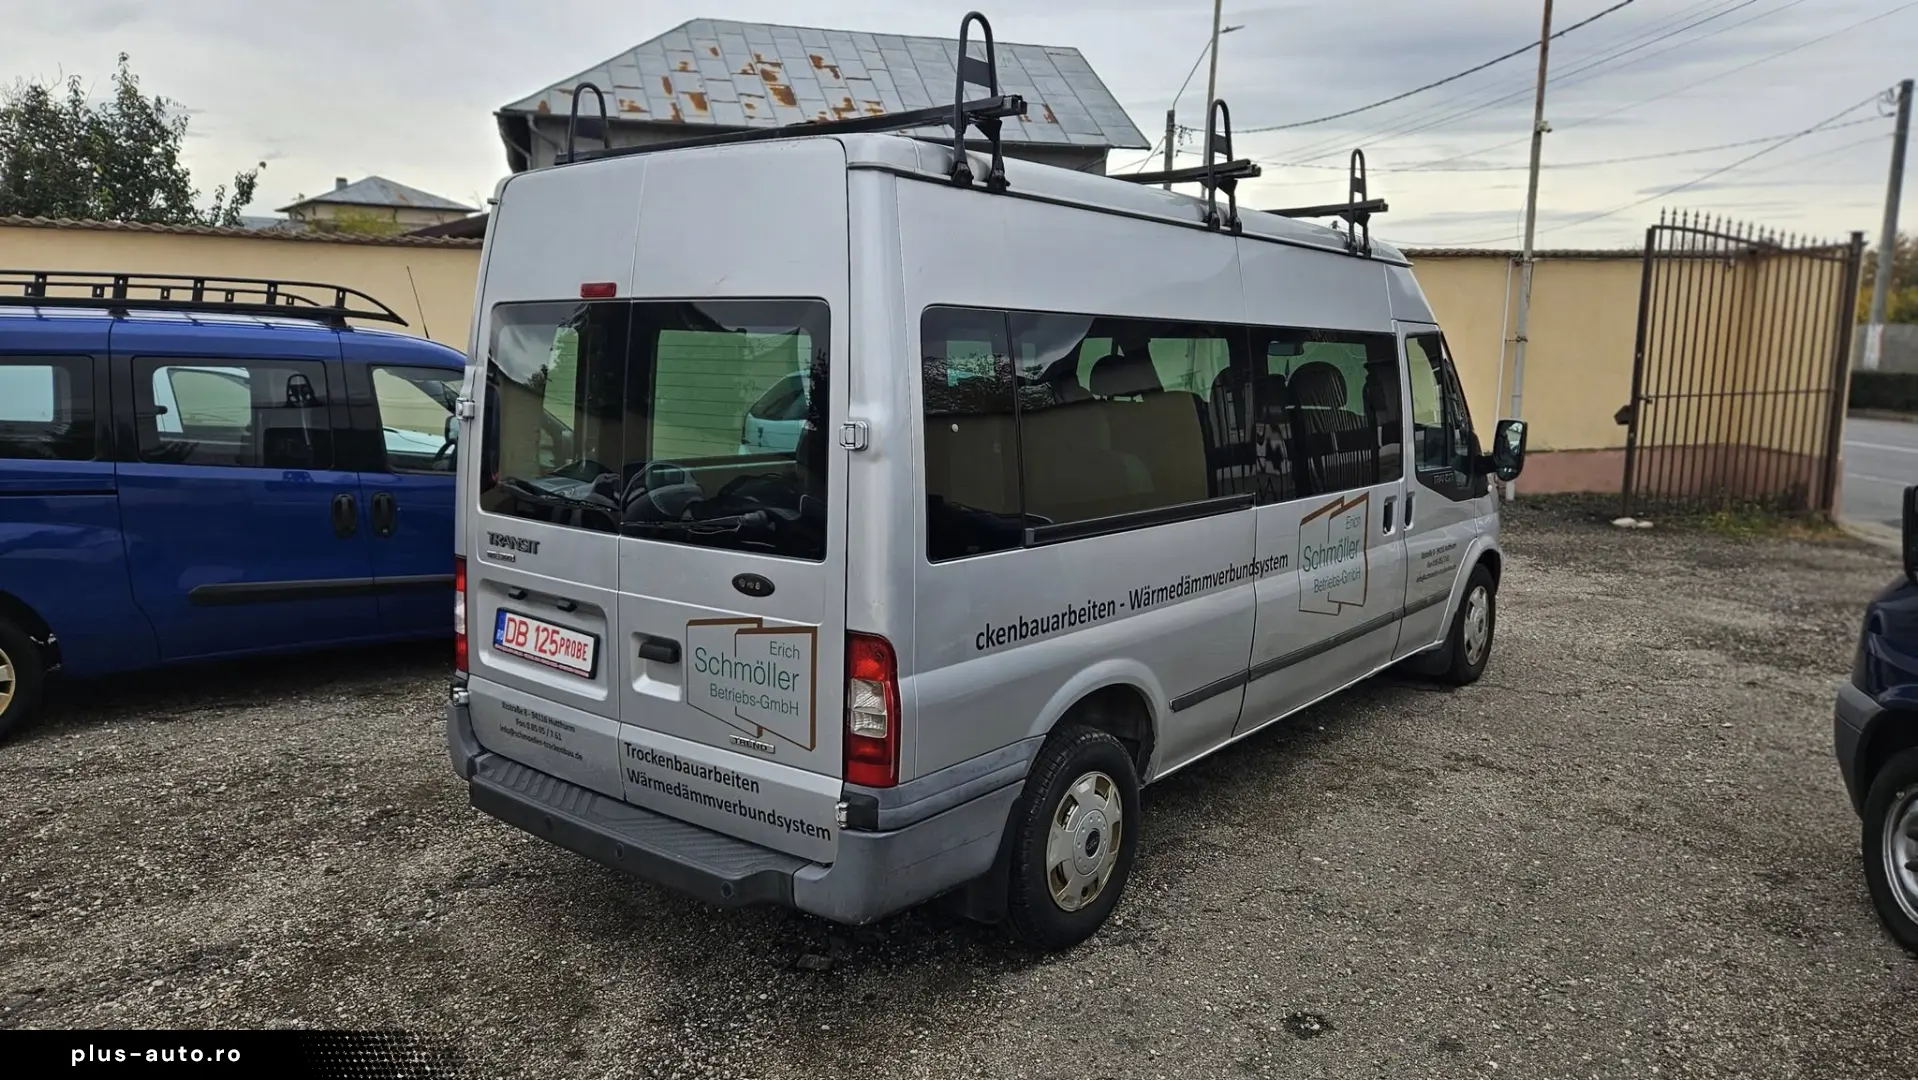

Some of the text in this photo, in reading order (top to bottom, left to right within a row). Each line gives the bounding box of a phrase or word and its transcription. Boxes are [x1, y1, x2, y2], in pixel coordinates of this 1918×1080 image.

[487, 531, 540, 554] TRANSIT
[1302, 536, 1360, 572] Schmöller
[1313, 566, 1361, 593] Betriebs-GmbH
[975, 599, 1115, 651] ckenbauarbeiten
[1129, 553, 1289, 610] Wärmedämmverbundsystem
[505, 617, 529, 647] DB
[769, 641, 800, 660] Erich
[695, 646, 800, 692] Schmöller
[709, 682, 799, 716] Betriebs-GmbH
[733, 737, 768, 751] TREND
[624, 741, 760, 794] Trockenbauarbeiten
[626, 767, 831, 841] Wärmedämmverbundsystem
